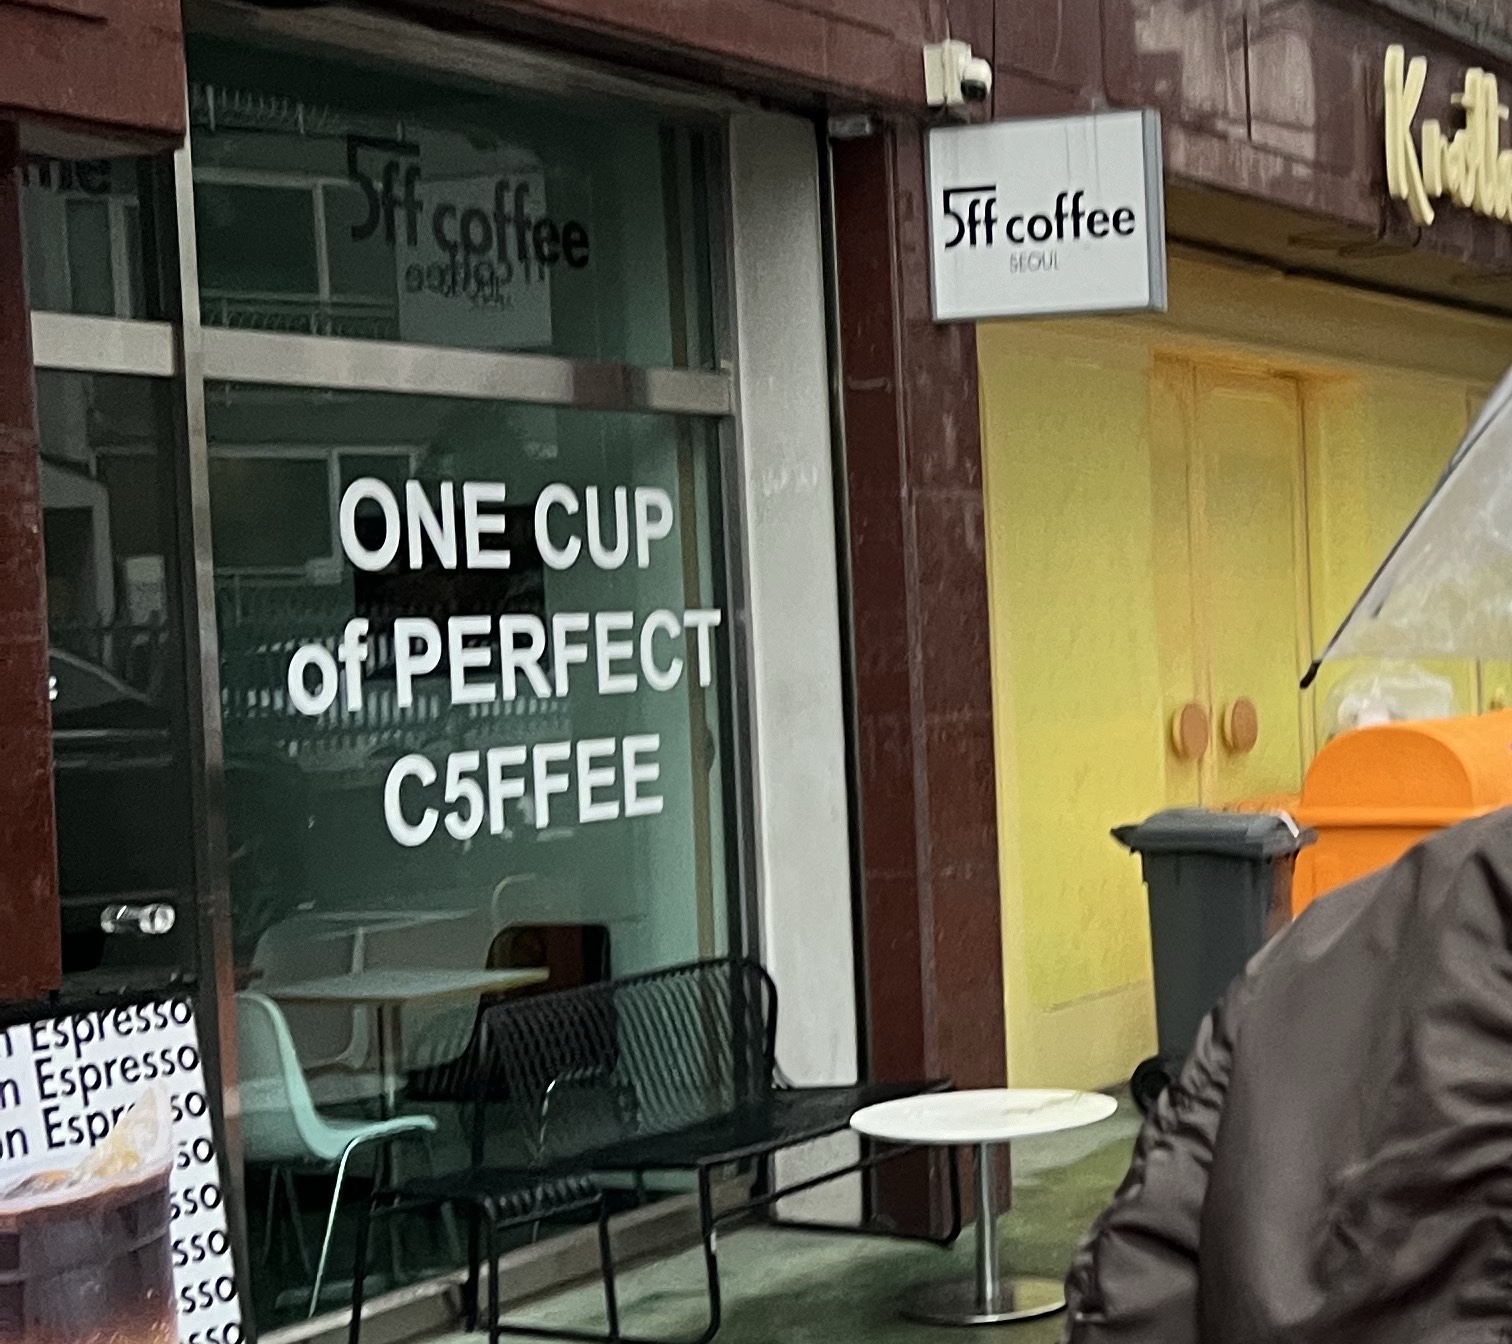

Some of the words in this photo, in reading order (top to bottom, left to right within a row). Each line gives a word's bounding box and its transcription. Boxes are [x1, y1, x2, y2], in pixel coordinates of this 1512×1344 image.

[347, 134, 423, 247] 5ff
[432, 178, 589, 269] coffee
[943, 185, 998, 248] 5ff
[1006, 189, 1136, 245] coffee
[339, 476, 511, 572] ONE
[534, 482, 674, 570] CUP
[287, 617, 369, 716] of
[394, 608, 722, 708] PERFECT
[384, 733, 664, 847] C5FFEE
[35, 1045, 200, 1106] Espresso
